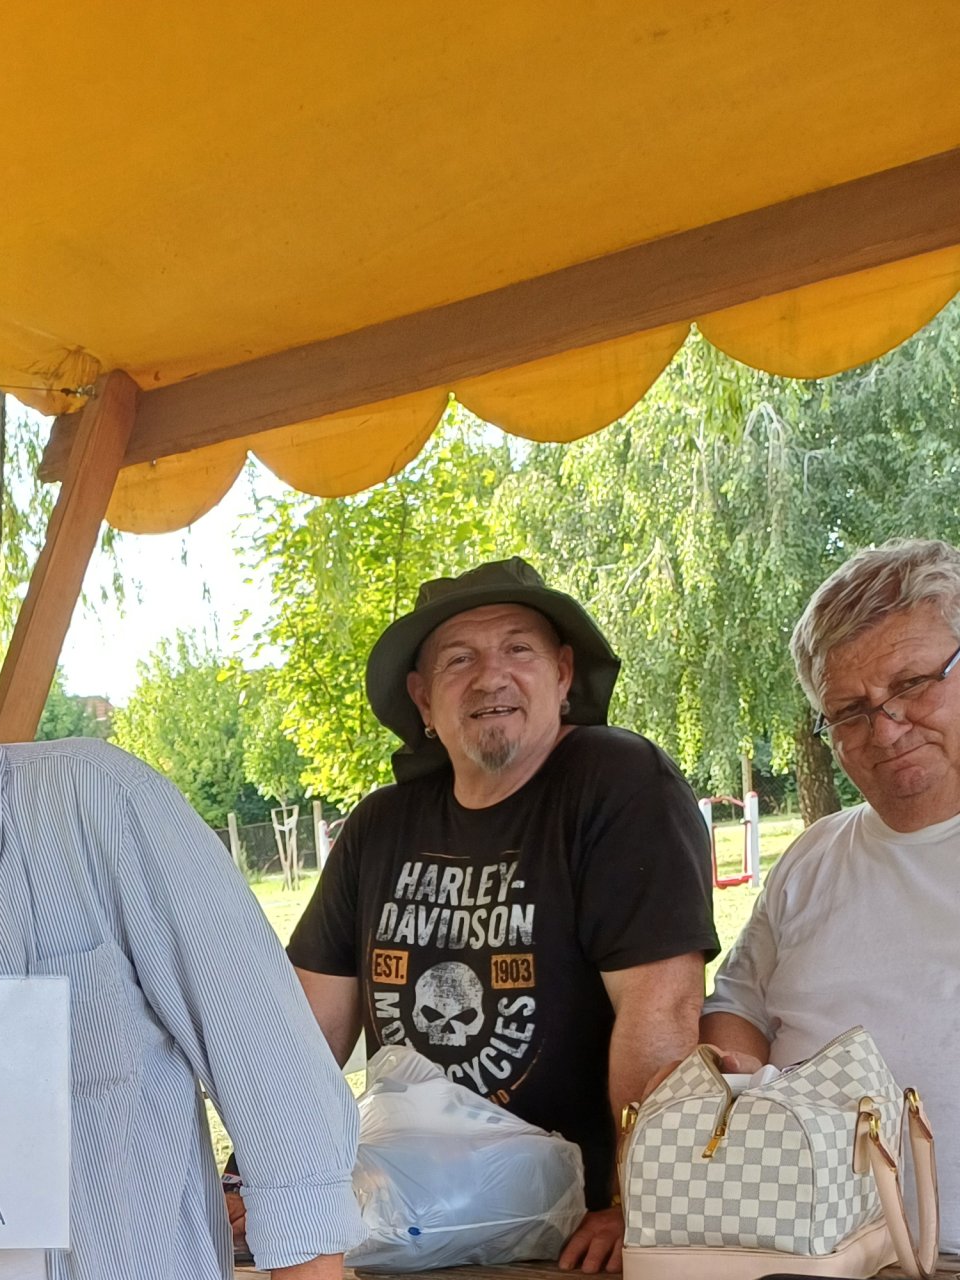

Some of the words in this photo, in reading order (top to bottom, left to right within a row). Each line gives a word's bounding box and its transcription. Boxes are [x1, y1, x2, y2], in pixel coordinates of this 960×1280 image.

[394, 861, 525, 906] HARLEY-
[375, 902, 535, 949] DAVIDSON
[374, 954, 405, 980] EST.
[492, 958, 532, 984] 1903
